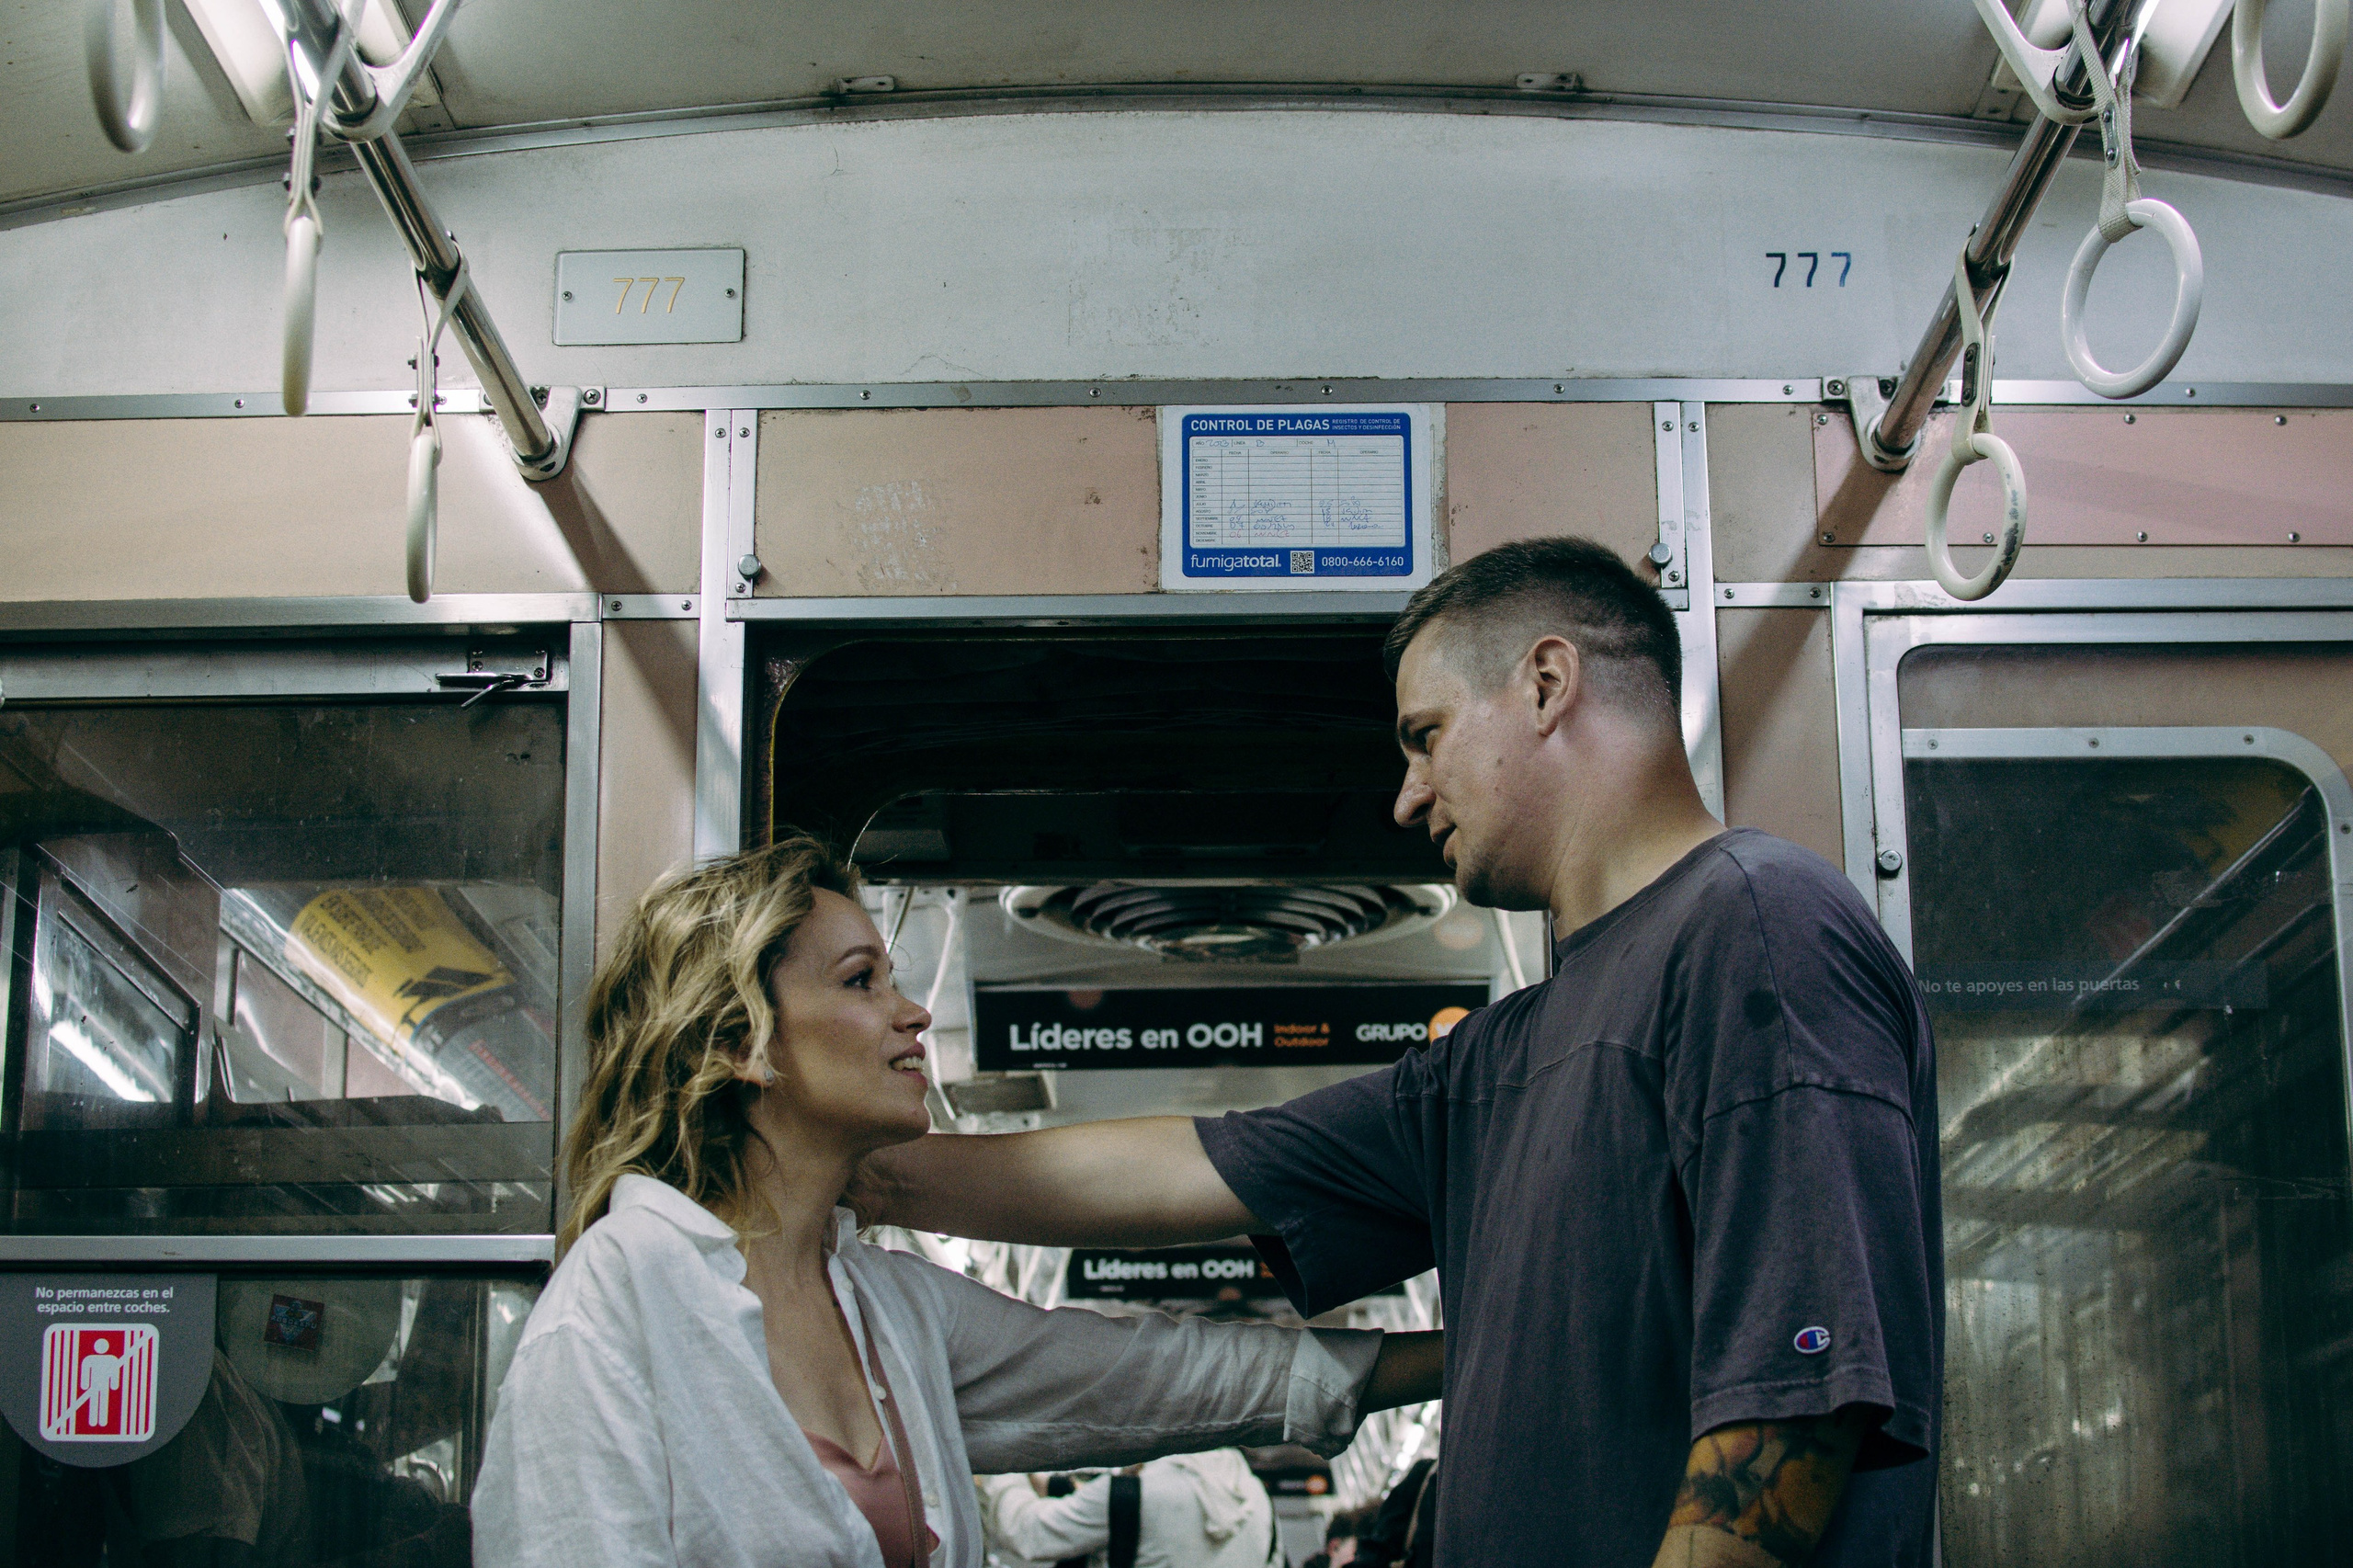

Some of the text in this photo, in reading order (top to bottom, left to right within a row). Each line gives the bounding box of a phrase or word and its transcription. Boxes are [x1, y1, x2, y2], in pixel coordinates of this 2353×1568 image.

[1765, 252, 1852, 288] 777
[612, 276, 686, 314] 777
[1190, 419, 1330, 431] CONTROL DE PLAGAS
[1321, 556, 1404, 567] 0800-666-6160
[1919, 978, 2140, 996] No te apoyes en las puertas
[1009, 1021, 1263, 1051] Líderes en OOH
[1273, 1023, 1317, 1034] Indoor
[1355, 1022, 1427, 1042] GRUPO
[1273, 1036, 1329, 1048] Outdoor
[1084, 1257, 1168, 1280] Líderes
[1170, 1262, 1199, 1280] en
[1201, 1258, 1256, 1279] OOH
[35, 1286, 174, 1301] No permanezcas en el
[37, 1301, 171, 1315] espacio entre coches.
